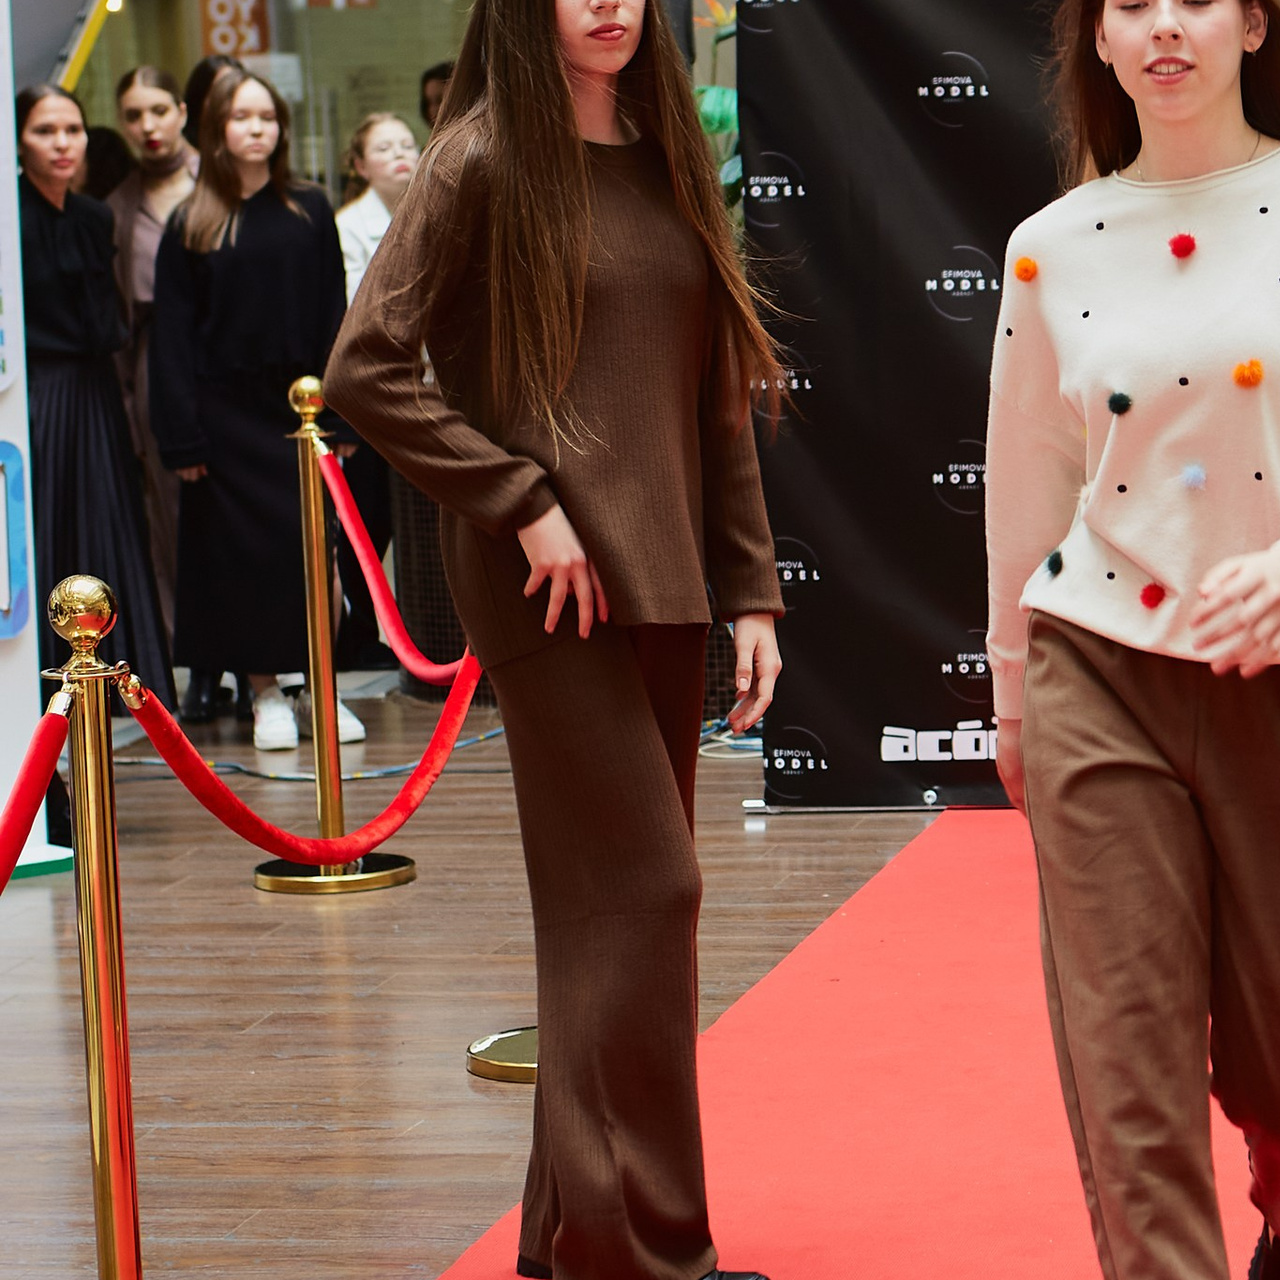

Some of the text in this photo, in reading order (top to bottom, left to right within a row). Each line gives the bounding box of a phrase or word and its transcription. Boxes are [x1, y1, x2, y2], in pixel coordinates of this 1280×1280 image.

[932, 76, 973, 85] EFIMOVA
[917, 84, 989, 98] MODEL
[748, 175, 790, 185] EFIMOVA
[941, 269, 983, 279] EFIMOVA
[925, 278, 1000, 292] MODEL
[773, 749, 812, 758] EFIMOVA
